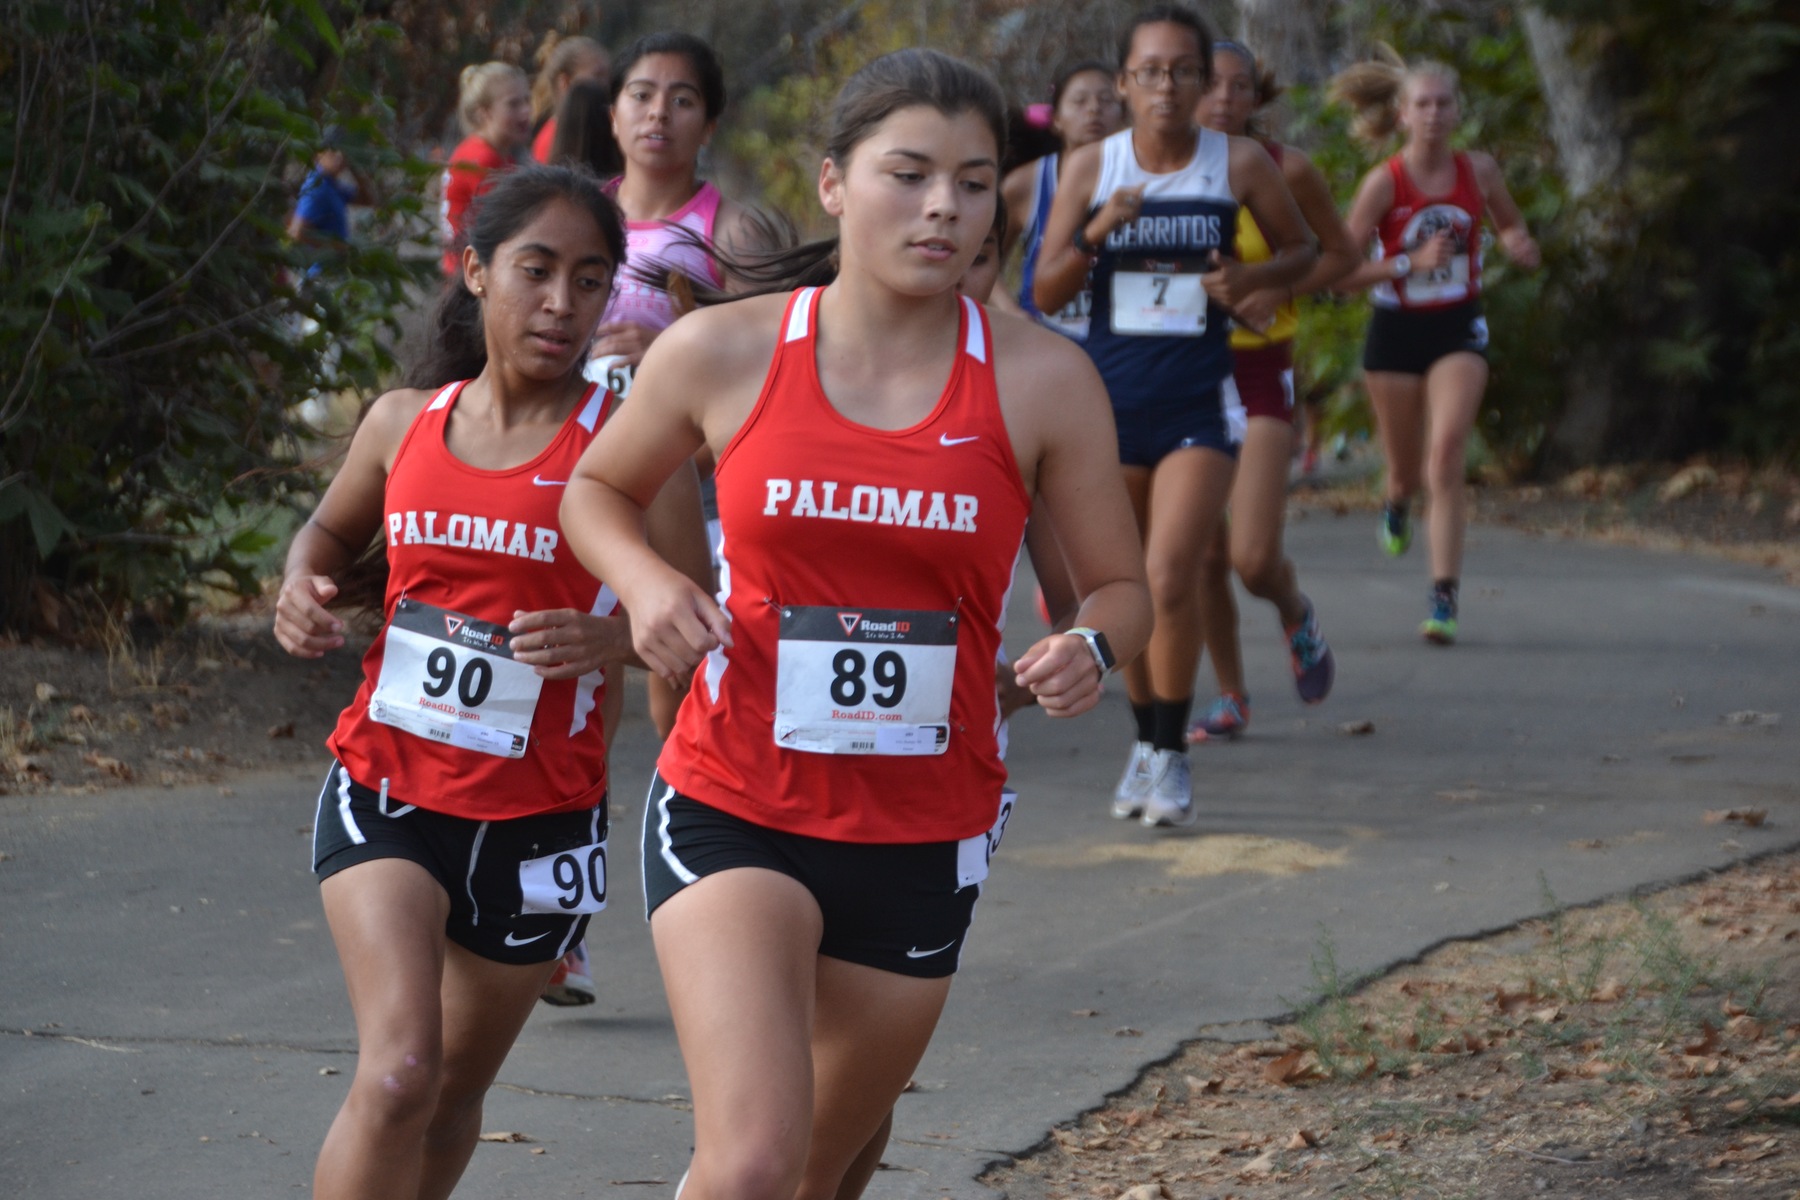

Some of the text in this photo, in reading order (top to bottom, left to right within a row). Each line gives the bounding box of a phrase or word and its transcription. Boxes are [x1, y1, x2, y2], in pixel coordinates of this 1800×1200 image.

[1152, 275, 1171, 306] 7
[607, 365, 636, 395] 6
[763, 478, 979, 533] PALOMAR
[388, 510, 559, 563] PALOMAR
[461, 625, 504, 646] RoadID
[861, 619, 911, 633] RoadID
[422, 646, 493, 708] 90
[830, 648, 907, 709] 89
[419, 696, 481, 721] RoadID.com
[831, 709, 903, 721] RoadID.com
[553, 846, 607, 910] 90
